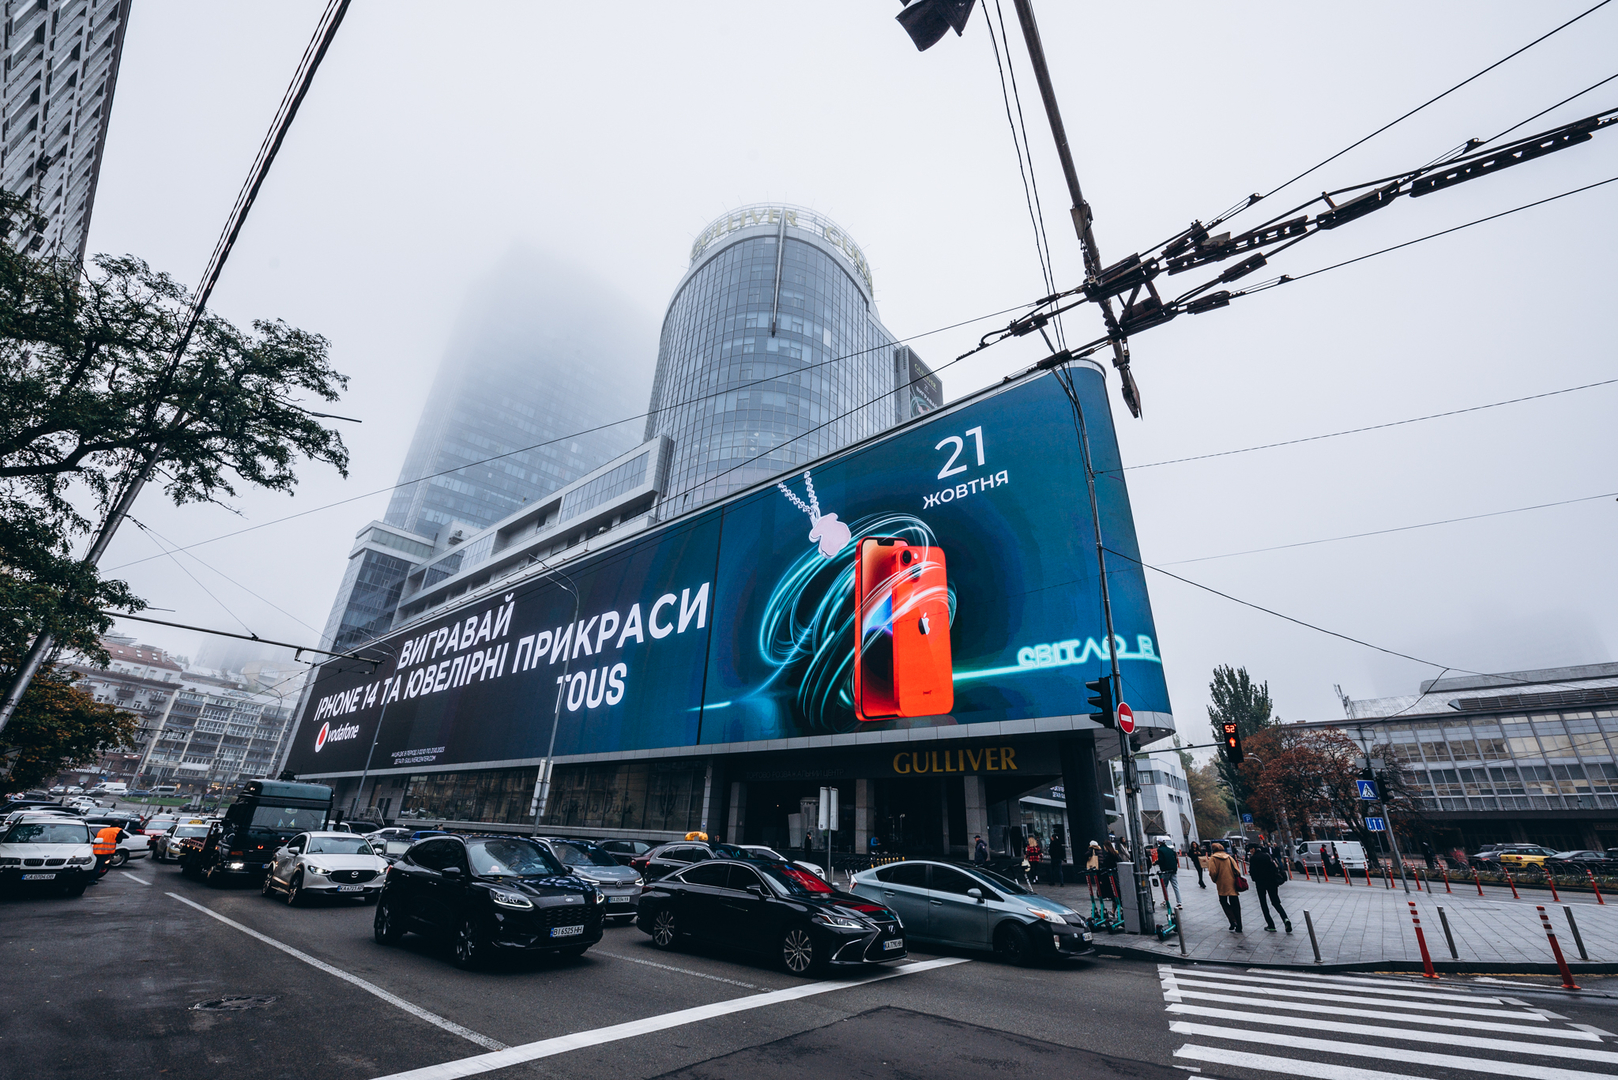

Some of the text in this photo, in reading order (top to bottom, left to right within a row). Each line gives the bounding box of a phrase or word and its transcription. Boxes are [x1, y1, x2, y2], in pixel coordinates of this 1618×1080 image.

[934, 425, 985, 480] 21
[922, 469, 1009, 509] ЖОВТНЯ
[313, 581, 710, 721] IPHONE 14 ТА ЮВЕЛІРНІ ПРИКРАСИ
[397, 592, 515, 670] ВИГРАВАЙ
[554, 662, 627, 714] TOUS
[327, 722, 360, 742] vodafone
[1224, 724, 1236, 733] 52
[893, 746, 1018, 774] GULLIVER
